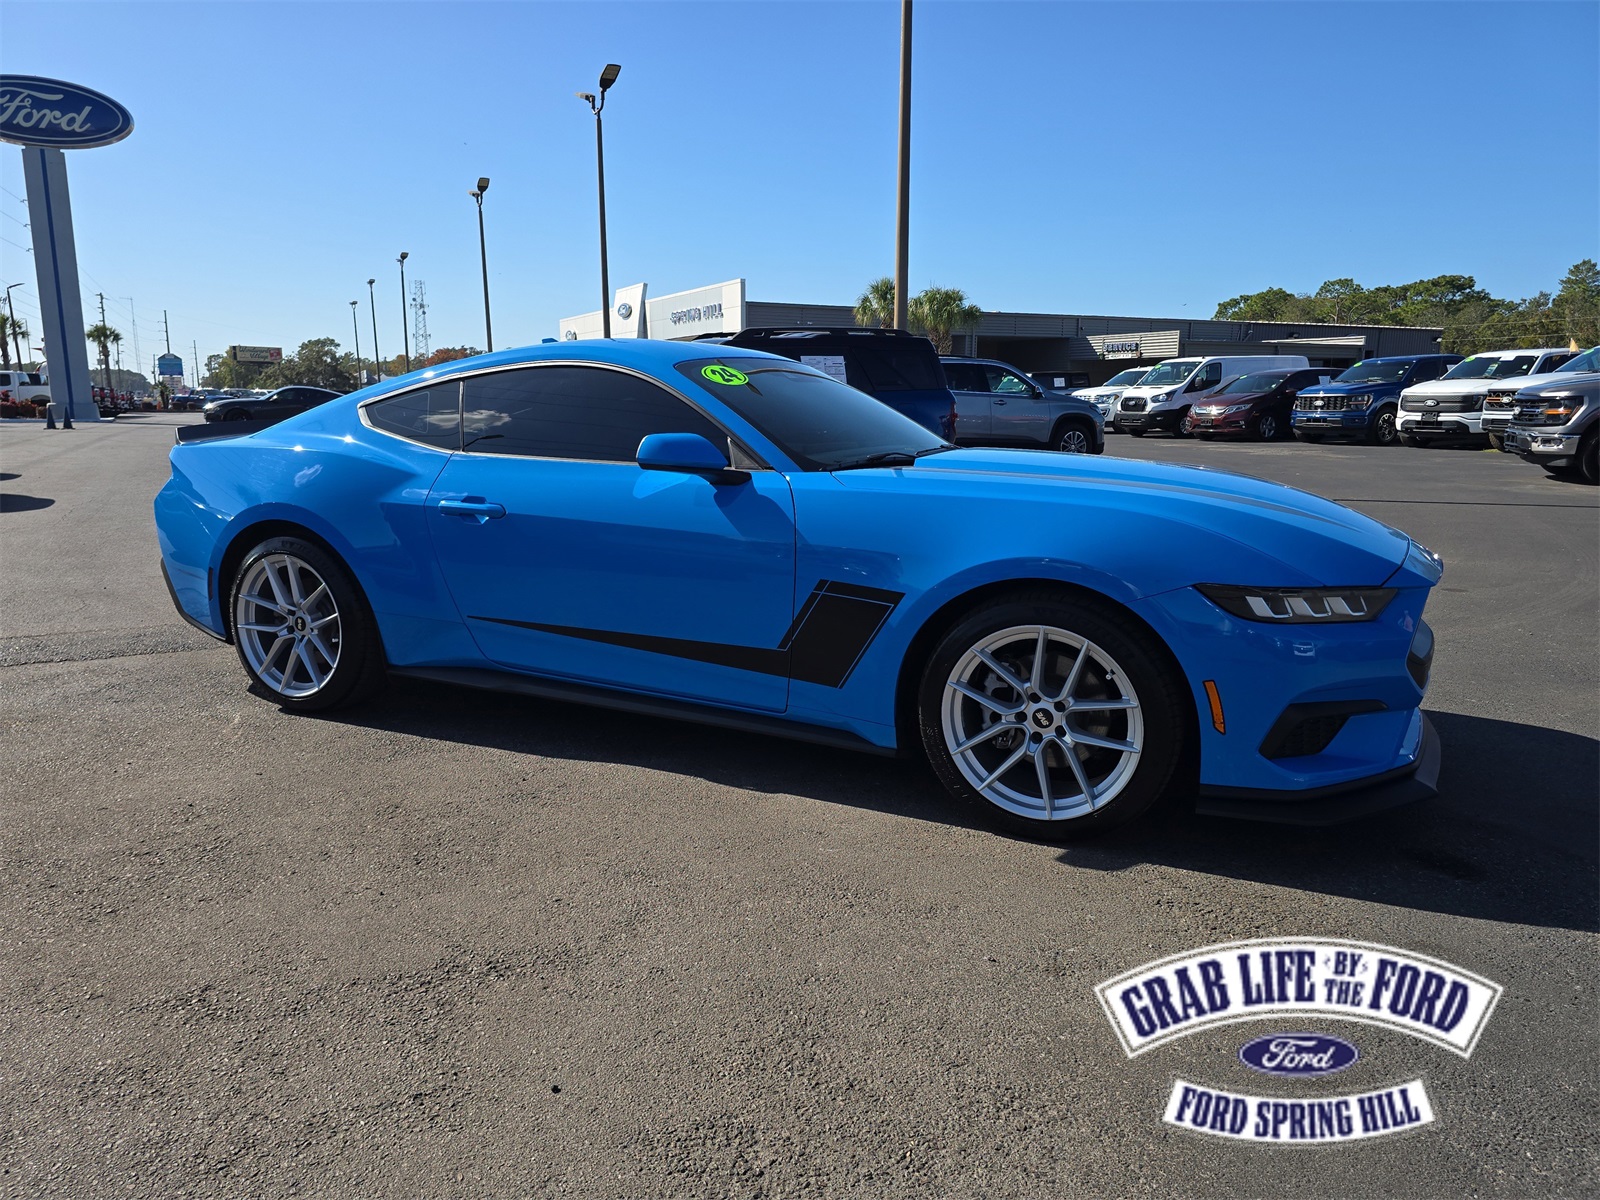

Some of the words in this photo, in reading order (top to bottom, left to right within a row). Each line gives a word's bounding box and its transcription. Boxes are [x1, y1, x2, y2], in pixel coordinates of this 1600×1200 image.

[0, 87, 92, 133] Ford
[670, 308, 702, 324] SPRING
[703, 303, 723, 319] HILL
[1103, 342, 1137, 352] SERVICE
[710, 367, 742, 383] 24
